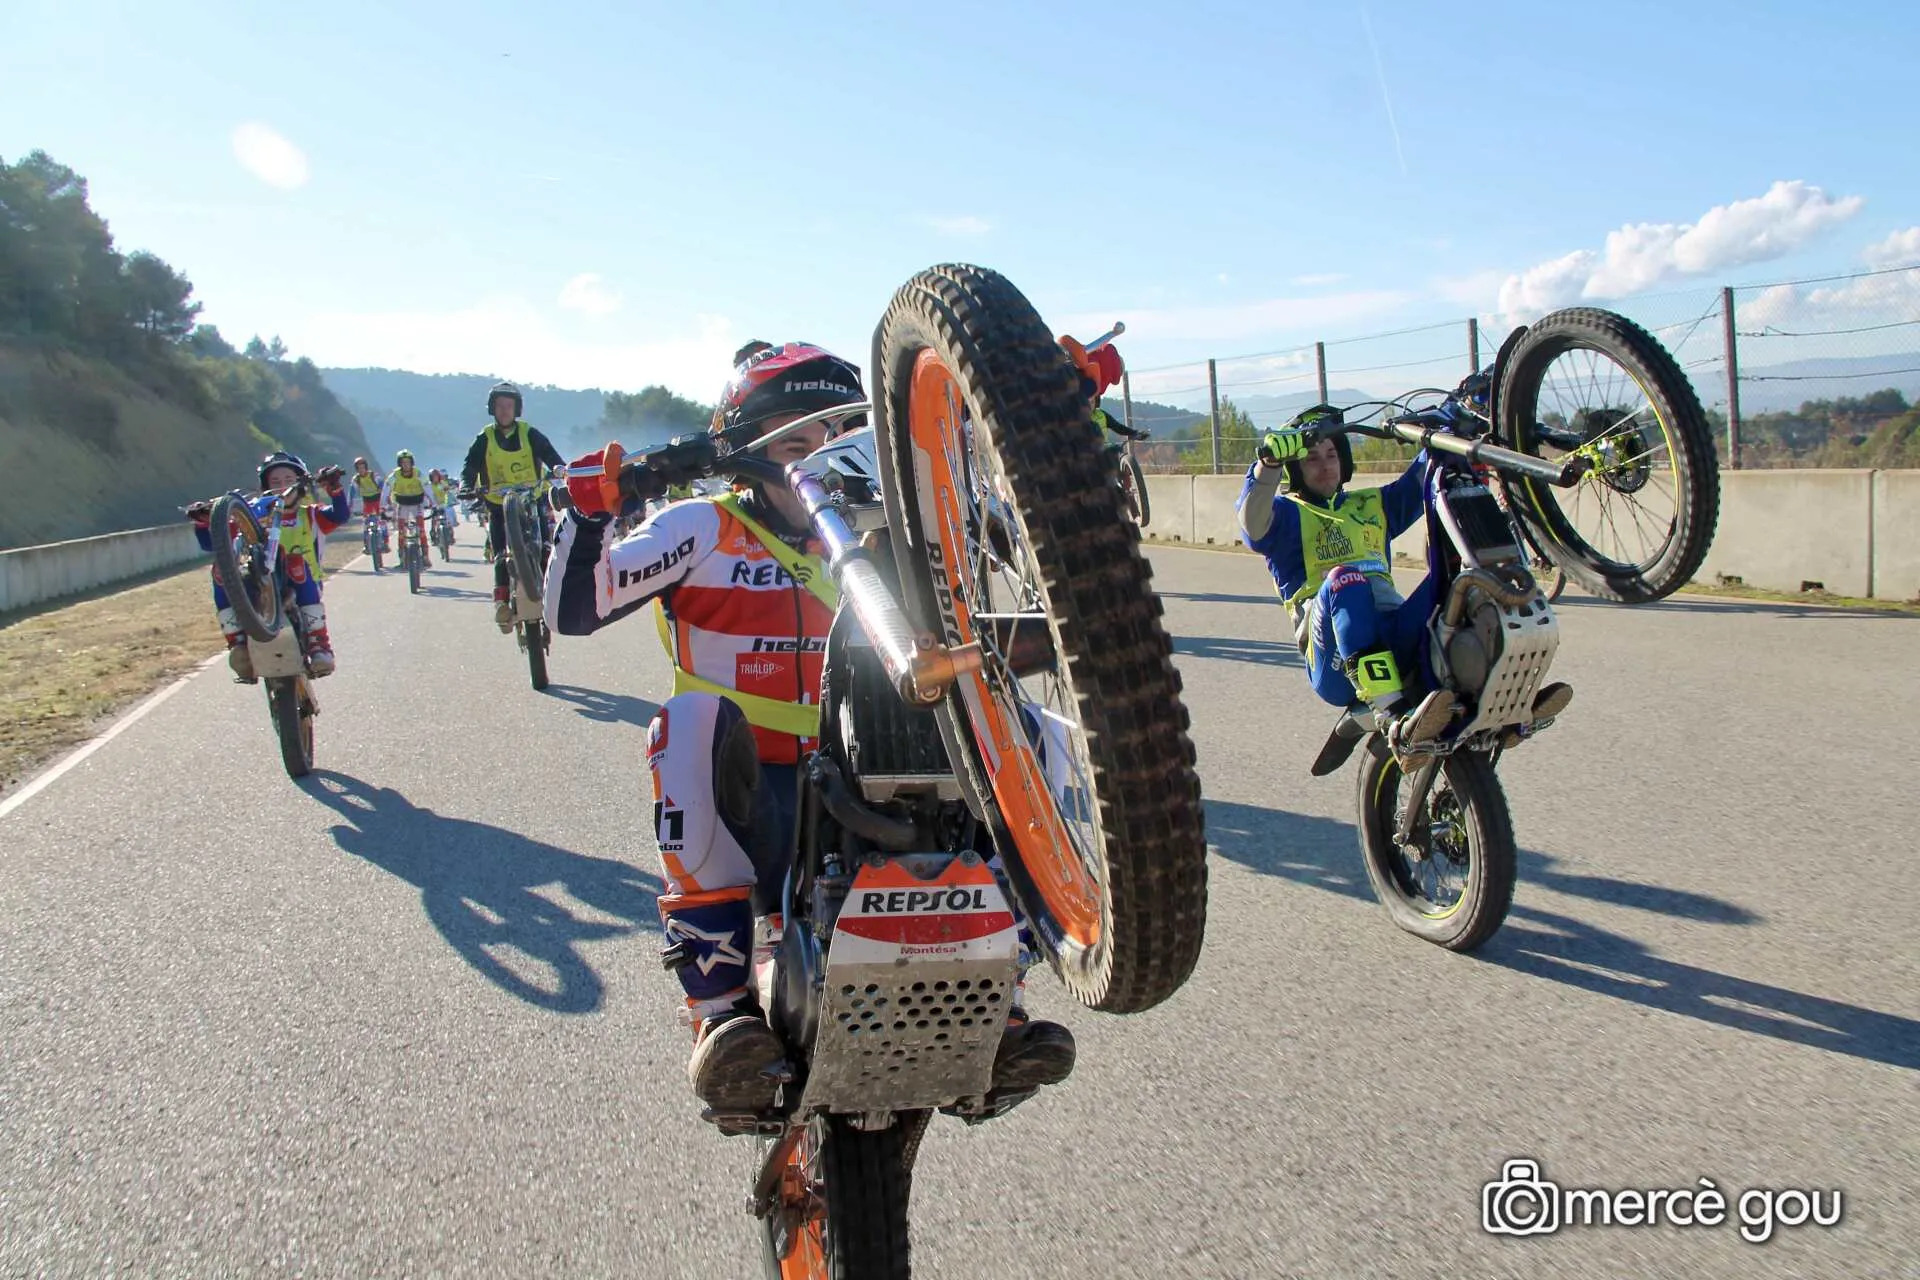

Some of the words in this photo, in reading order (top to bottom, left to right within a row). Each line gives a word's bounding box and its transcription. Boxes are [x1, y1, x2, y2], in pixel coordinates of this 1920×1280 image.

[784, 379, 848, 394] hebo
[618, 536, 695, 588] hebo
[1331, 571, 1368, 592] MOTUL
[740, 663, 775, 675] TRIALGP
[861, 889, 987, 913] REPSOL
